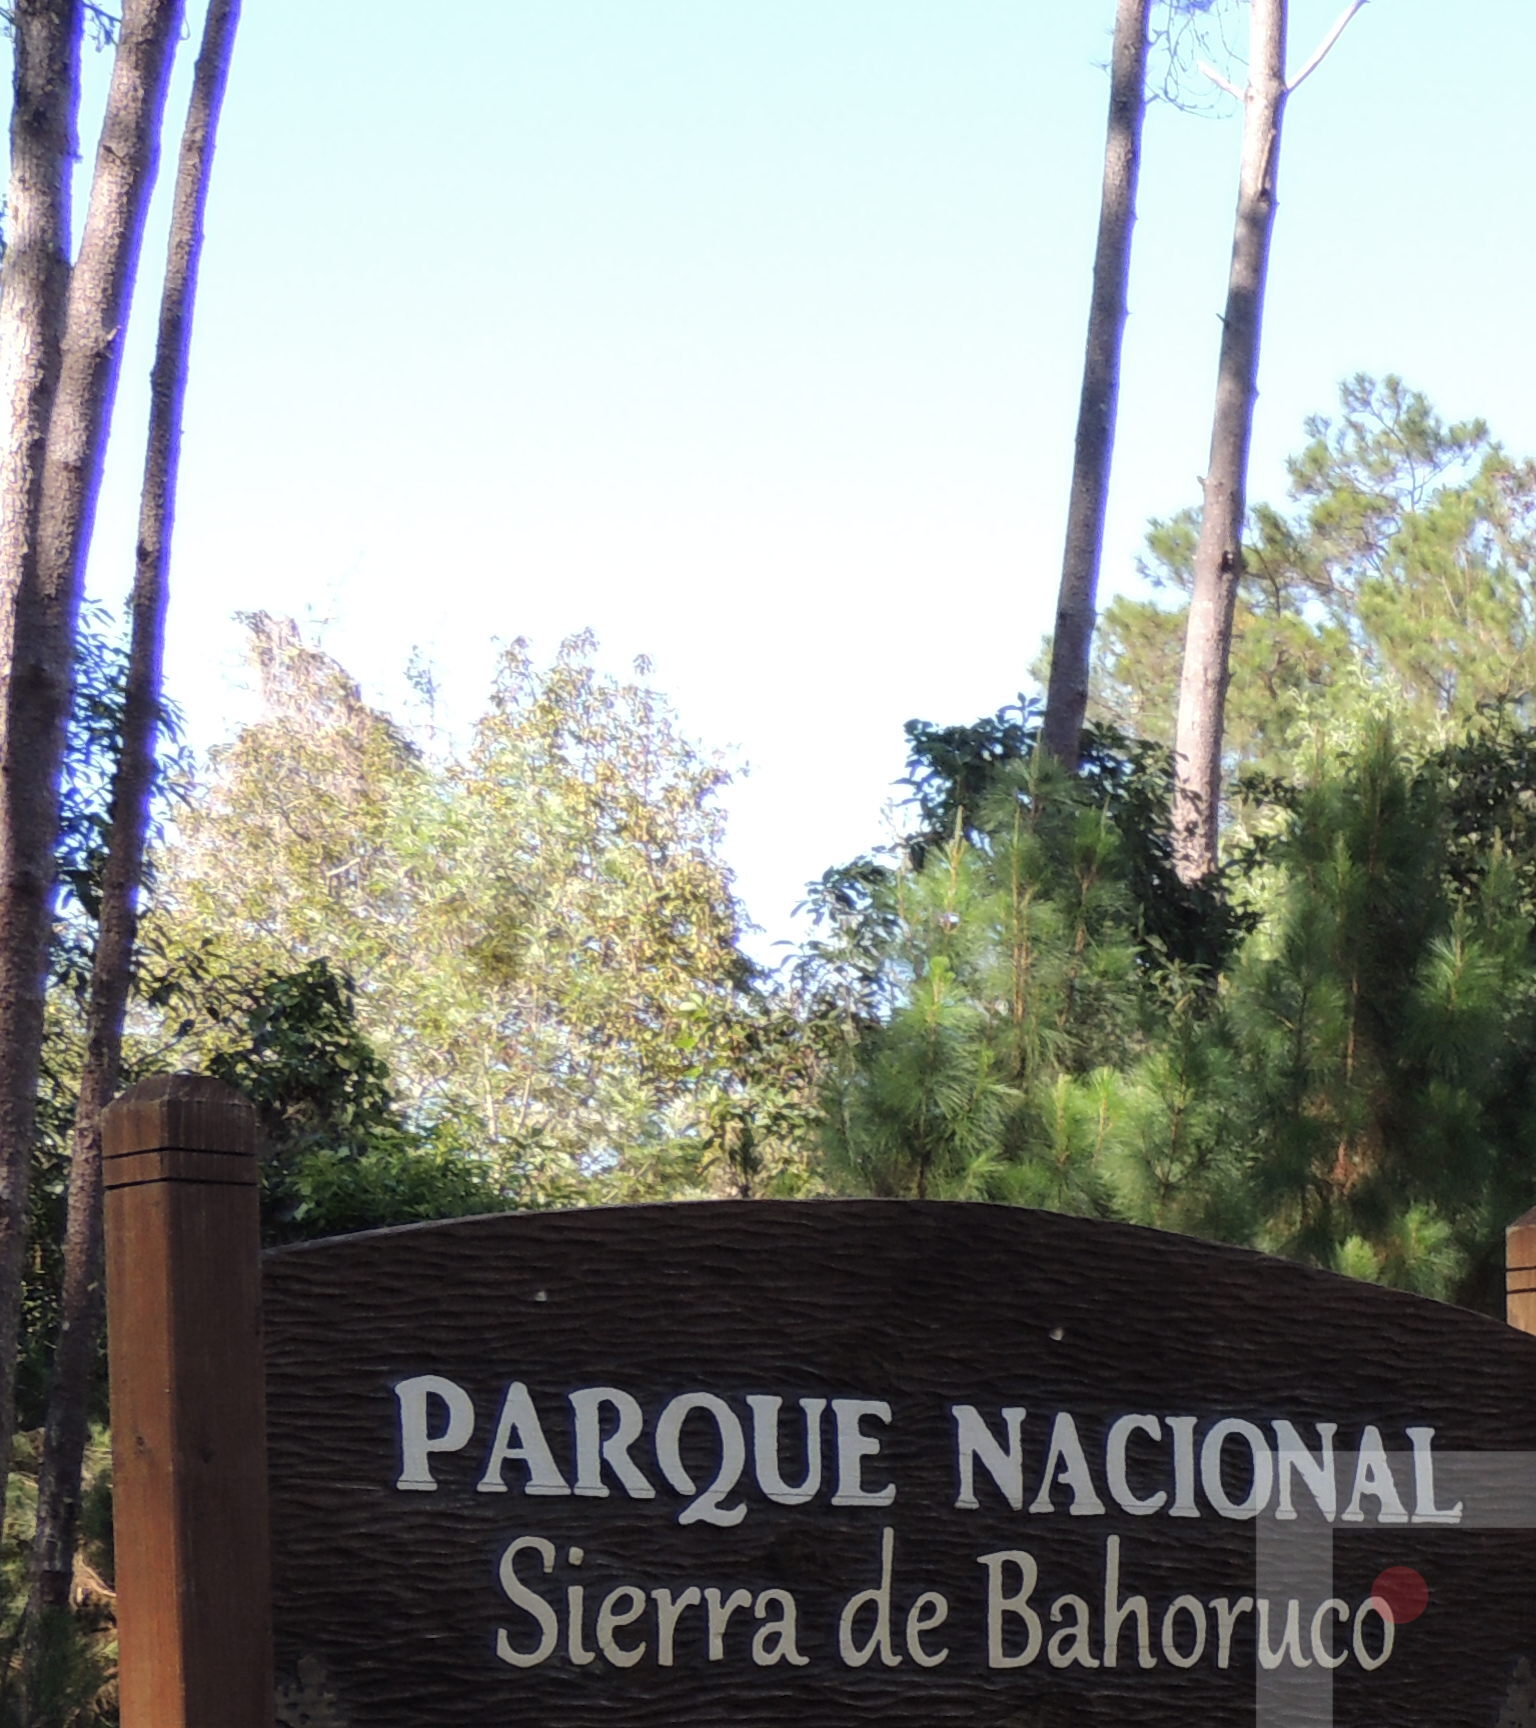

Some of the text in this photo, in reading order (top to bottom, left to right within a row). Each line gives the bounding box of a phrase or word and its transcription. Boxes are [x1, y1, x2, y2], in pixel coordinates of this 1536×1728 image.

[394, 1374, 1464, 1527] PARQUE NACIONAL
[495, 1526, 1395, 1672] Sierra de Bahoruco
